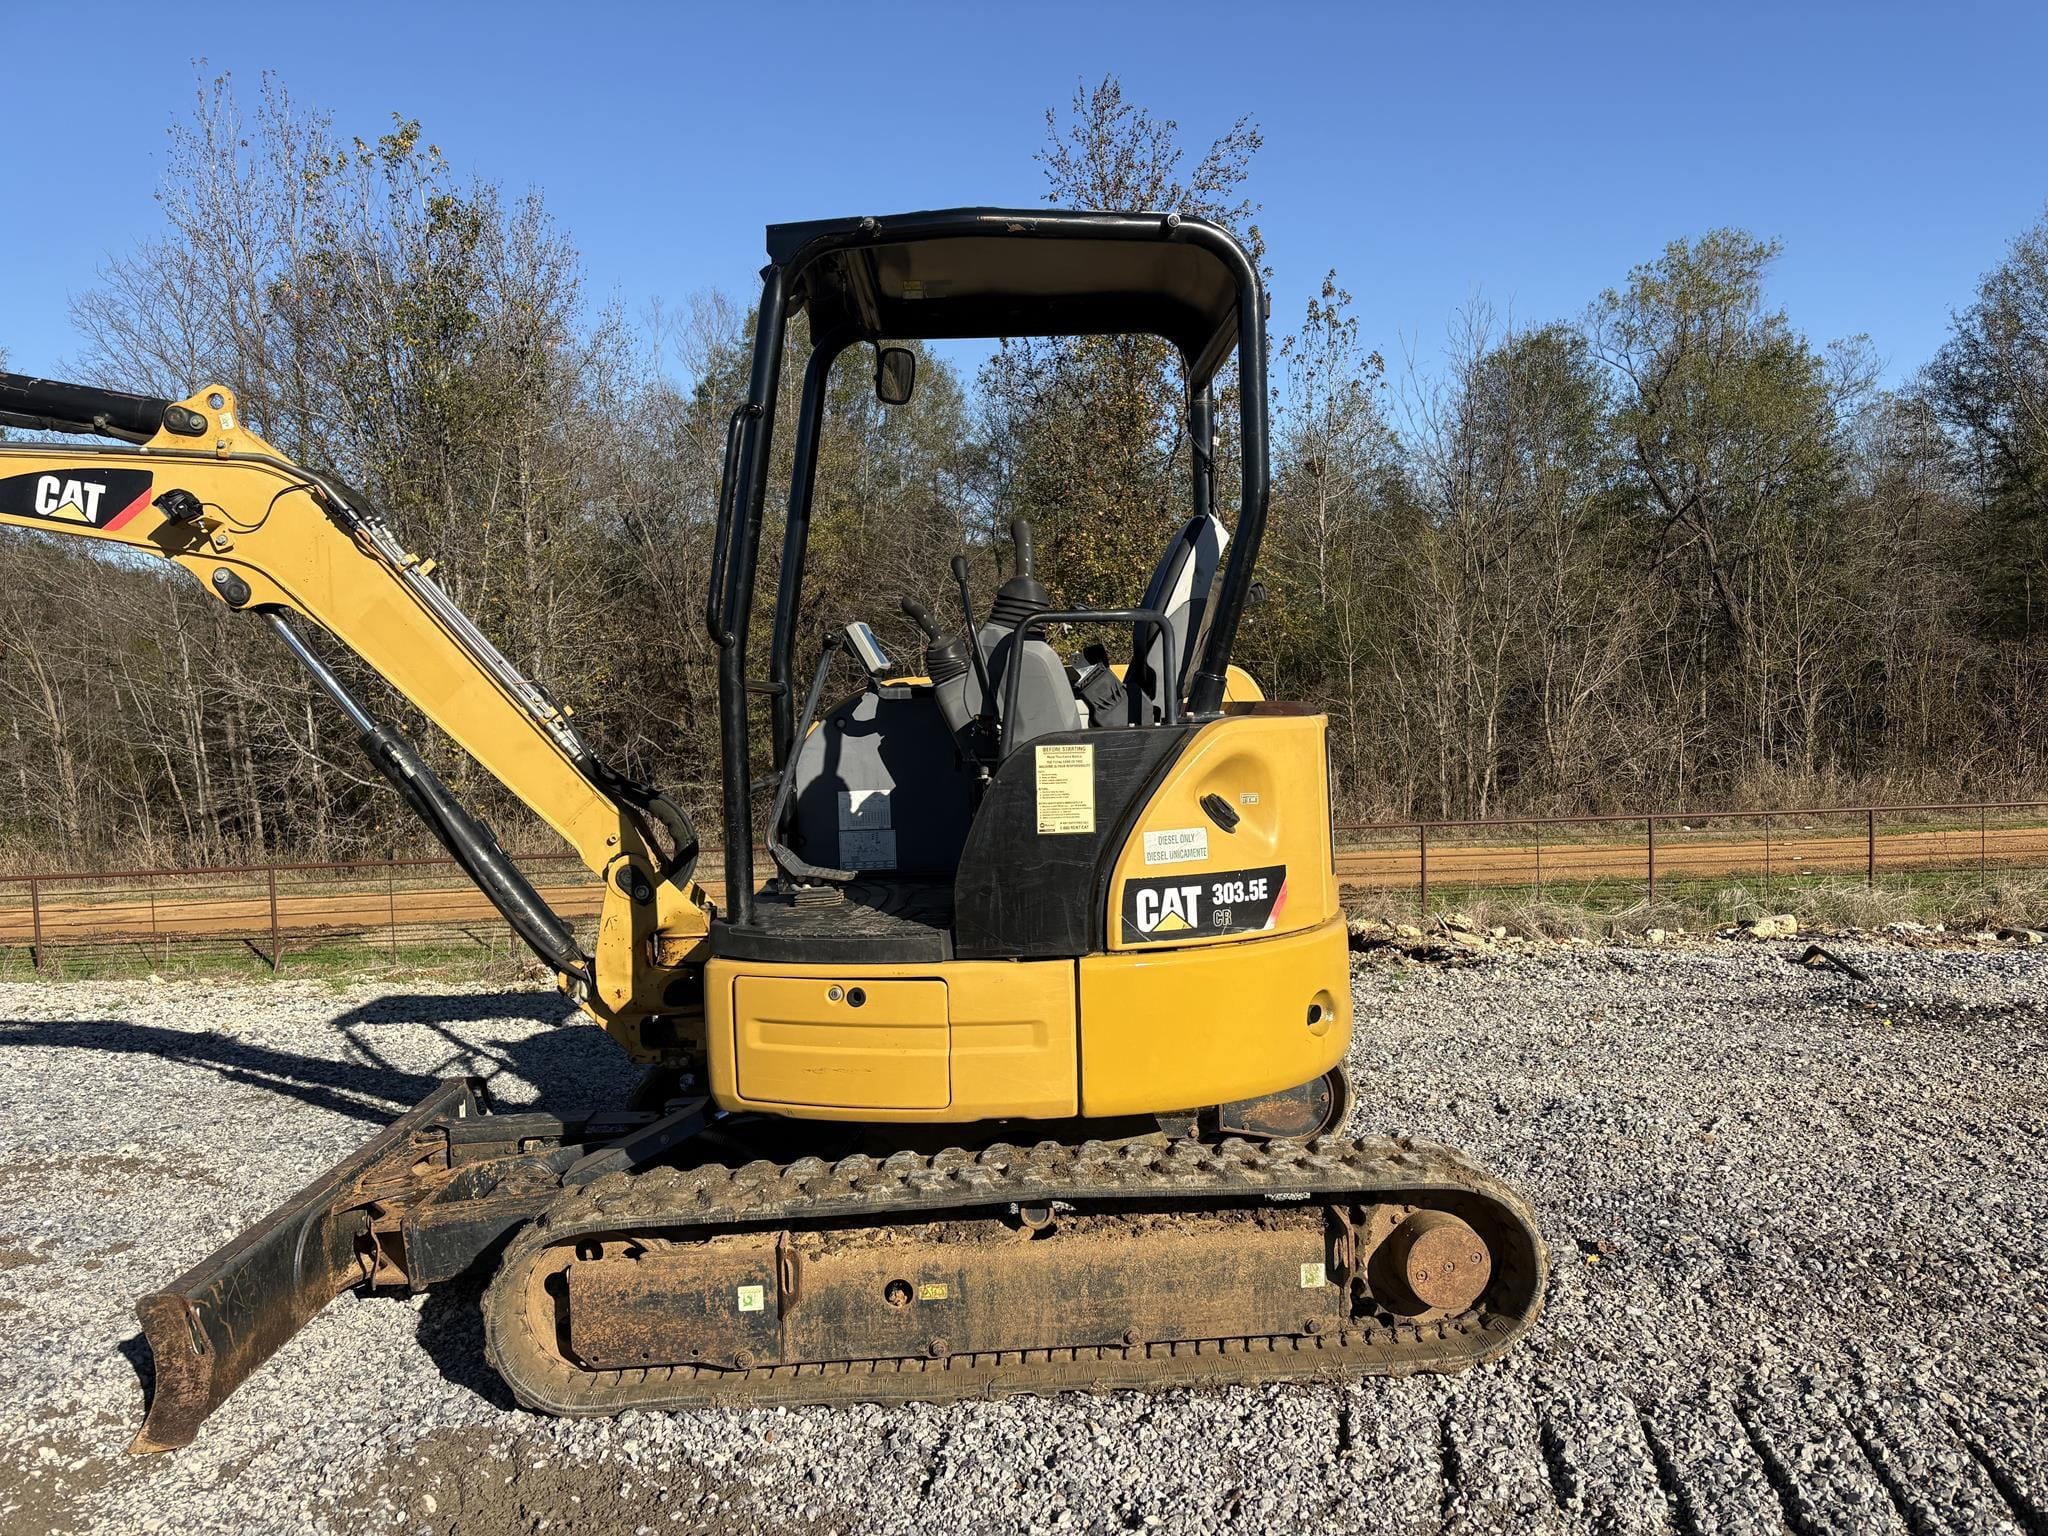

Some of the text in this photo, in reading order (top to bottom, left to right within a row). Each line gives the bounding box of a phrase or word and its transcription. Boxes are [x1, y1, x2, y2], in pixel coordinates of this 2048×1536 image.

[35, 475, 107, 524] CAT
[1158, 833, 1195, 846] DIESEL ONLY
[1146, 847, 1207, 861] DIESEL UNICAMENTE
[1136, 878, 1268, 933] CAT 303.5E
[1213, 909, 1232, 927] CR
